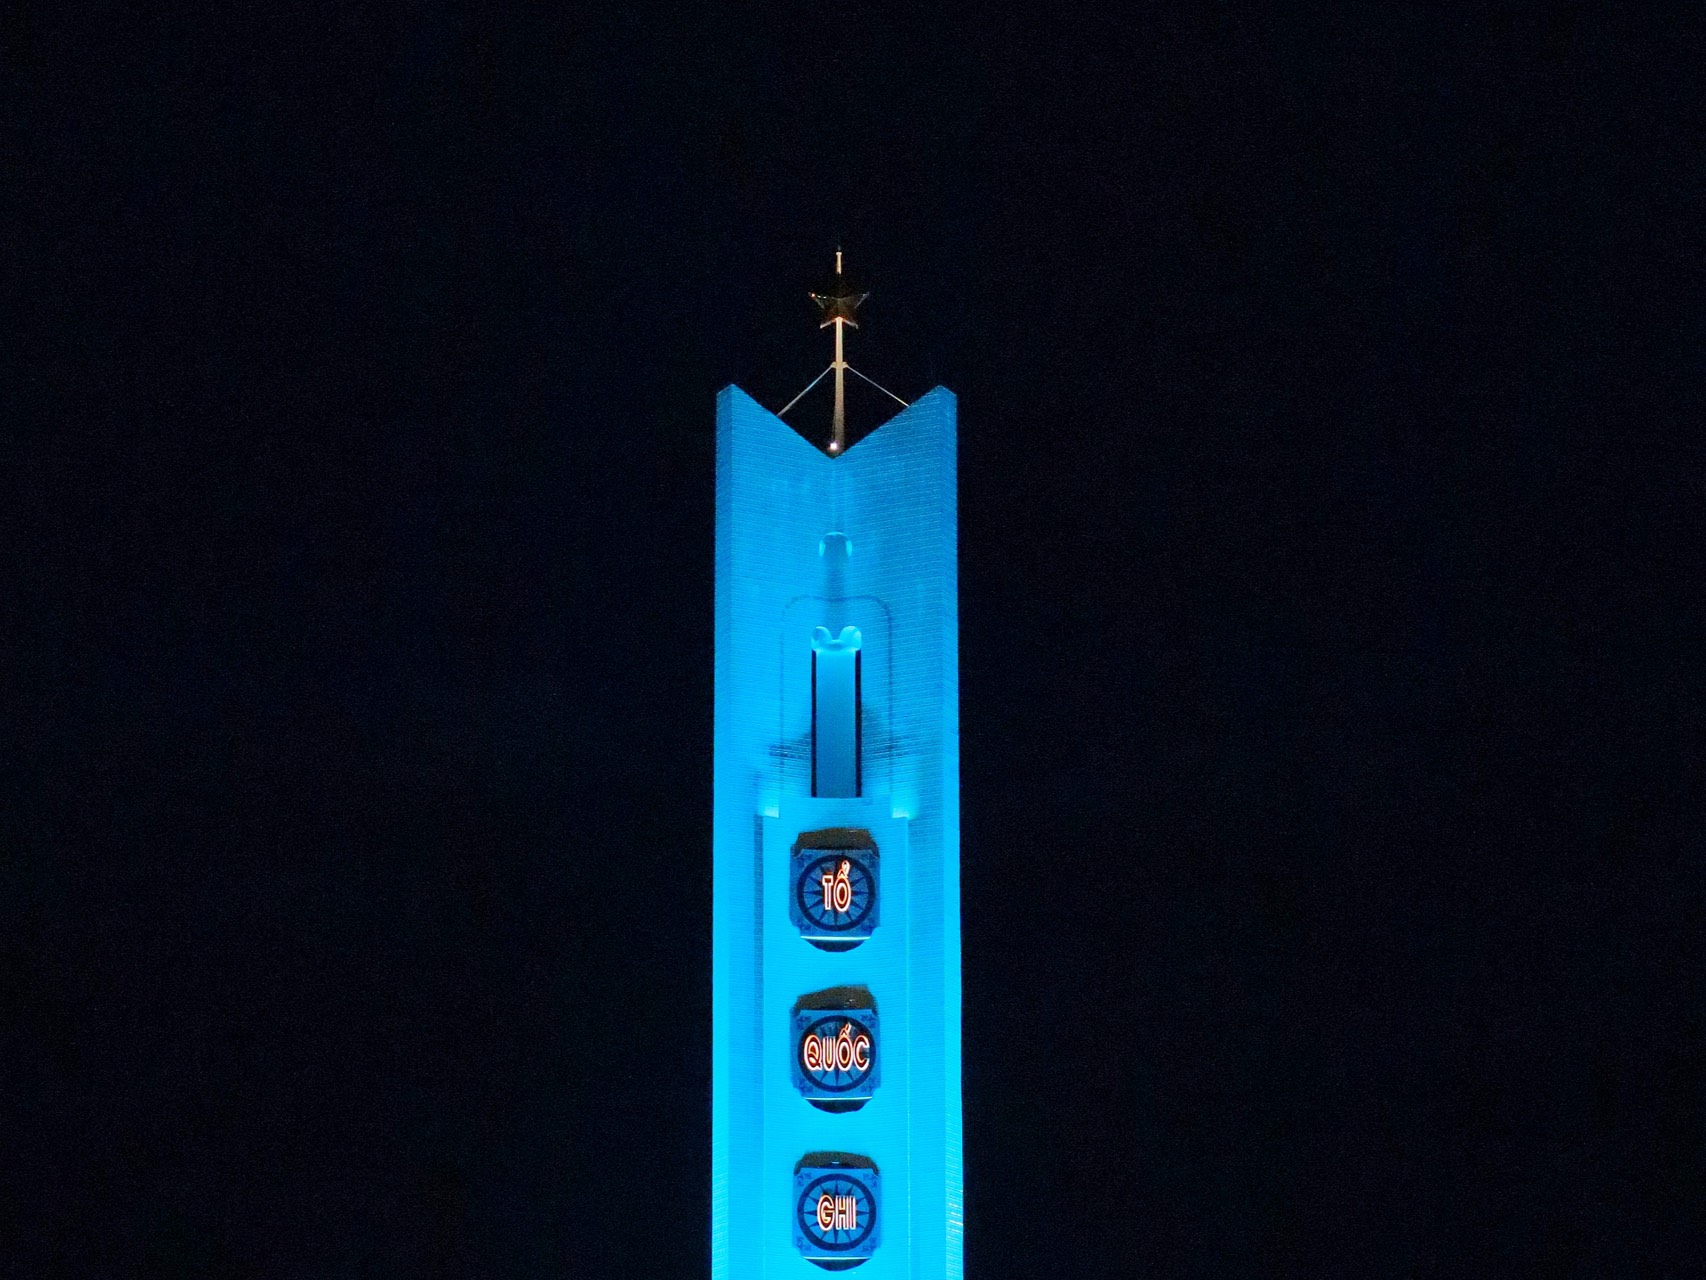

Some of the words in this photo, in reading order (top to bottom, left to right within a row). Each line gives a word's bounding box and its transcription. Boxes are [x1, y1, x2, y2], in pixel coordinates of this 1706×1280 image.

[822, 860, 851, 912] TỔ
[803, 1022, 870, 1072] QUỐC
[817, 1194, 857, 1231] GHI
